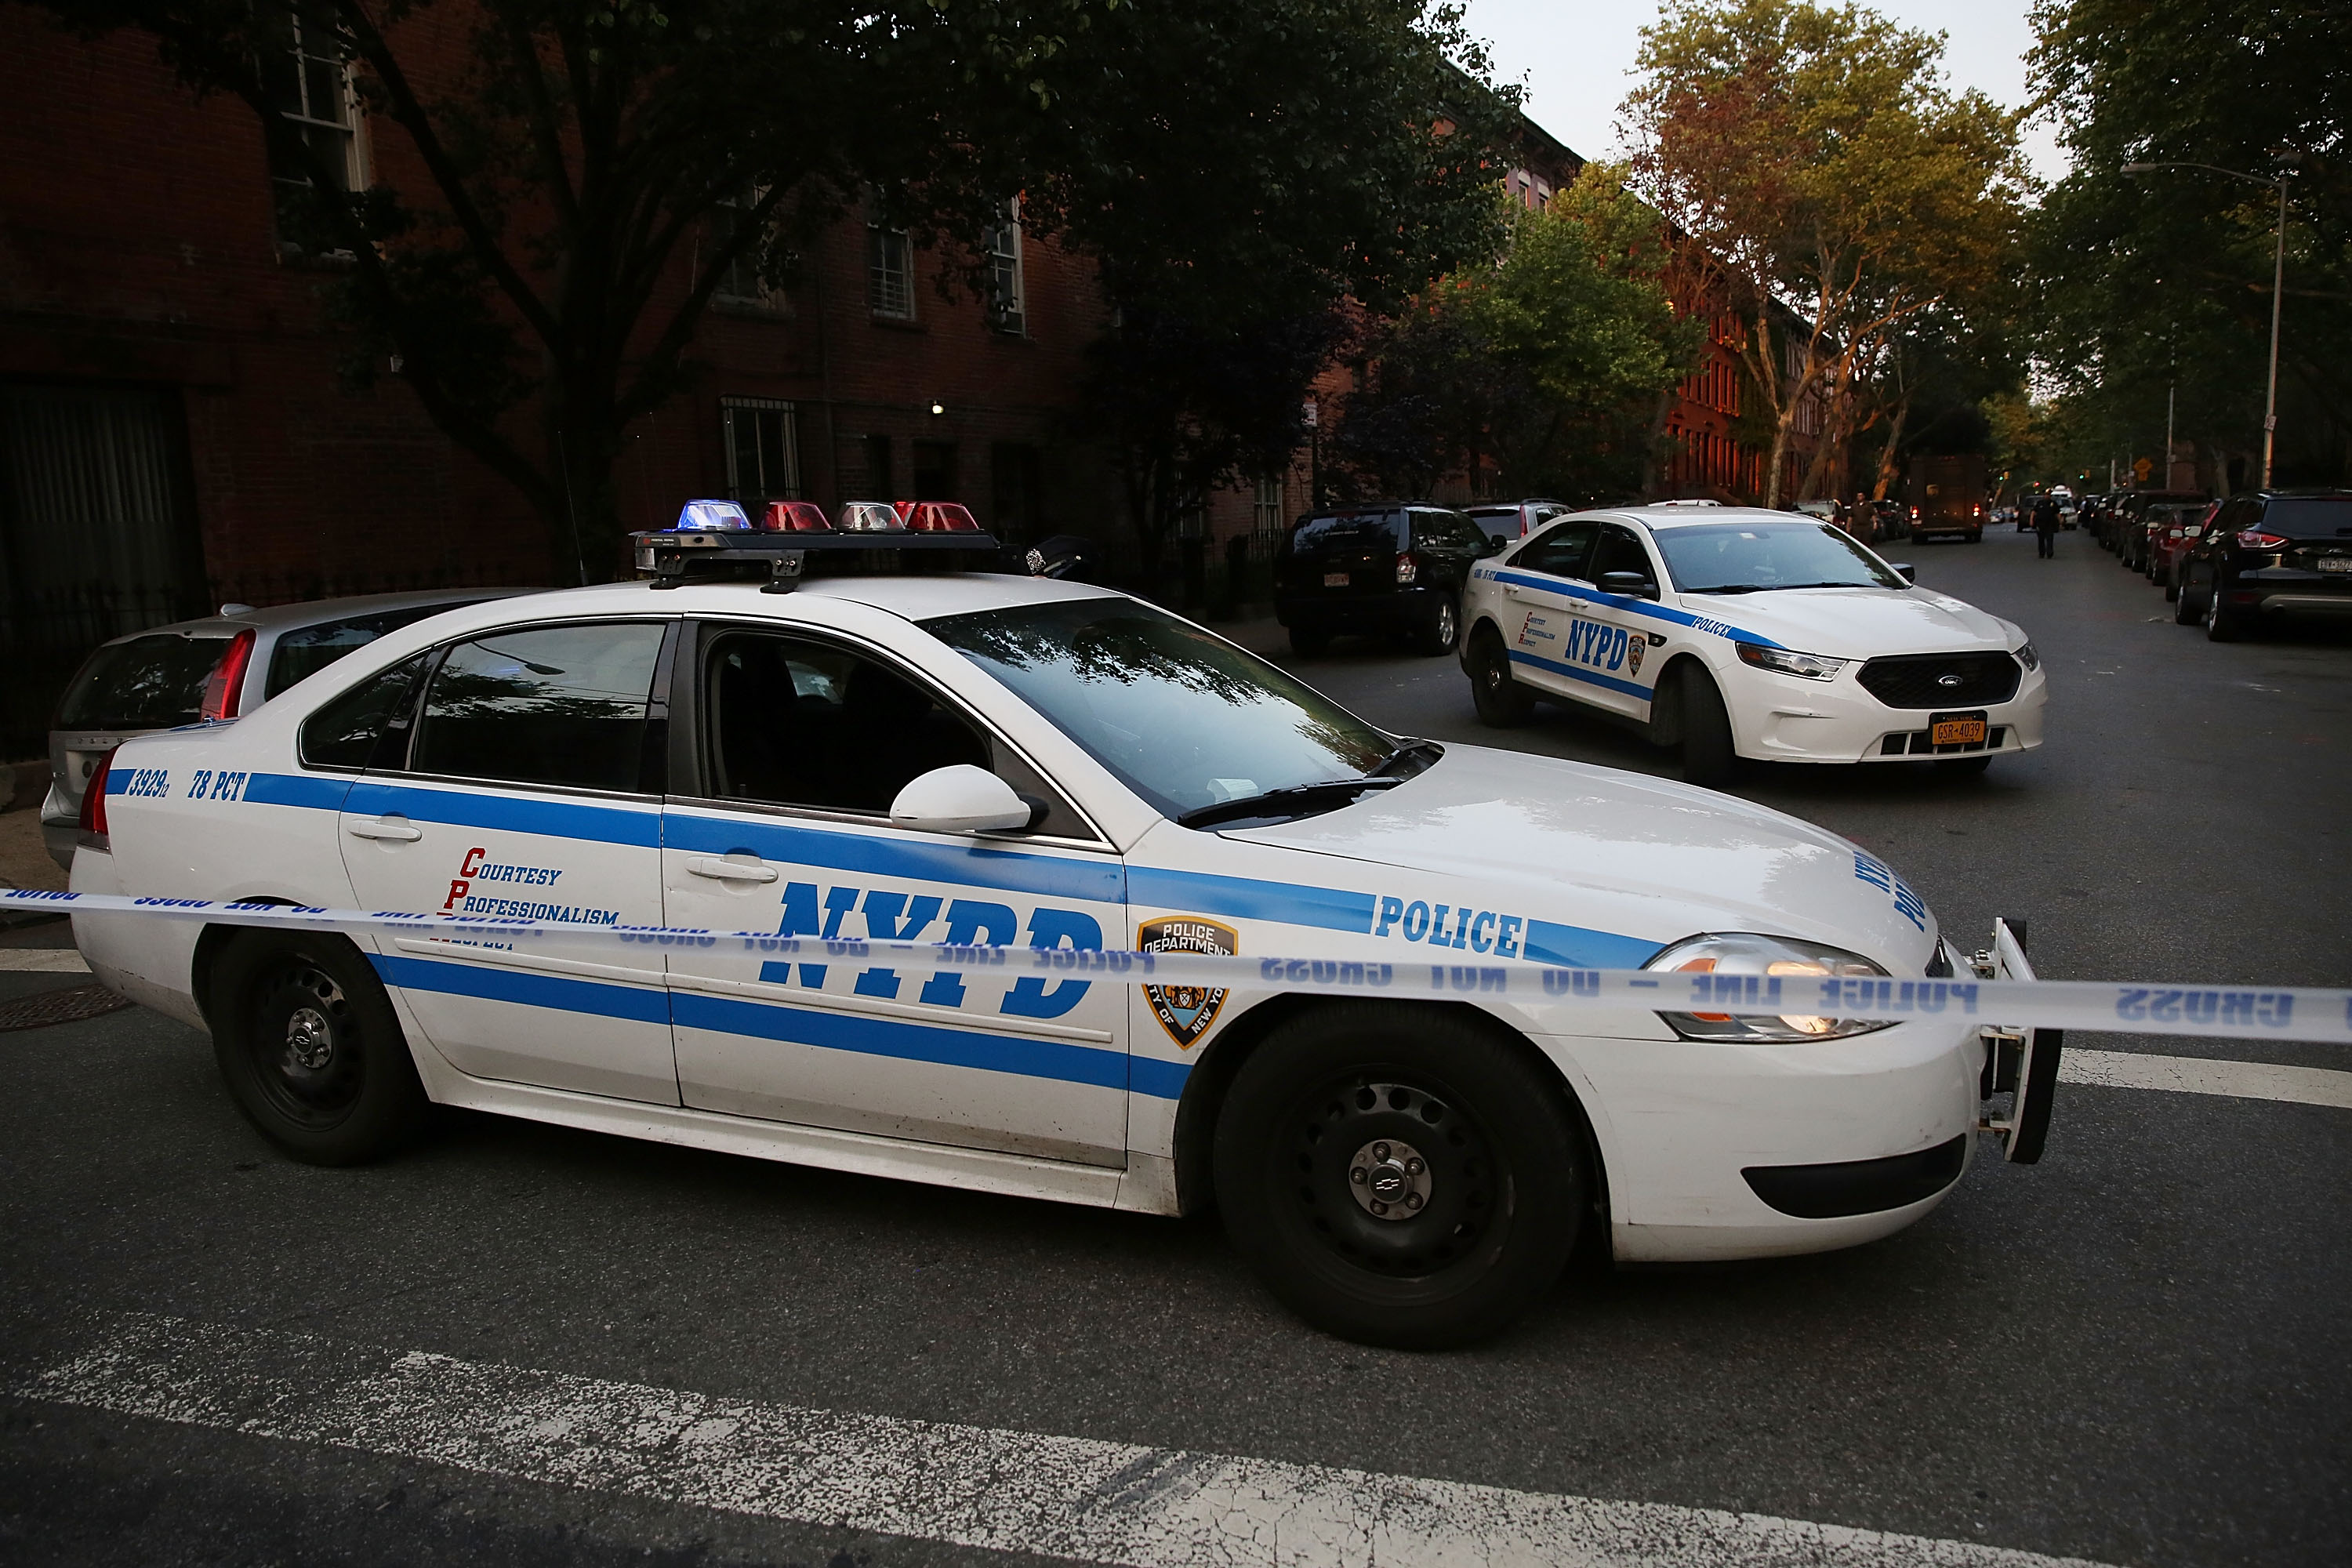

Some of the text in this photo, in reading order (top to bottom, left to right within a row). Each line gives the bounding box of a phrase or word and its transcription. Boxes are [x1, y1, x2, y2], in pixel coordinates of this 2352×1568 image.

[1565, 619, 1628, 671] NYPD
[1691, 616, 1731, 637] POLICE
[187, 770, 212, 800] 78
[209, 771, 247, 801] PCT
[459, 847, 562, 886] COURTESY
[443, 879, 619, 926] PROFESSIONALISM
[1144, 936, 1231, 956] DEPARTMENT
[1163, 923, 1215, 942] POLICE
[1374, 895, 1523, 959] POLICE
[758, 881, 1103, 1019] NYPD
[1148, 983, 1174, 1025] TY OF
[1191, 986, 1226, 1034] NEW YO
